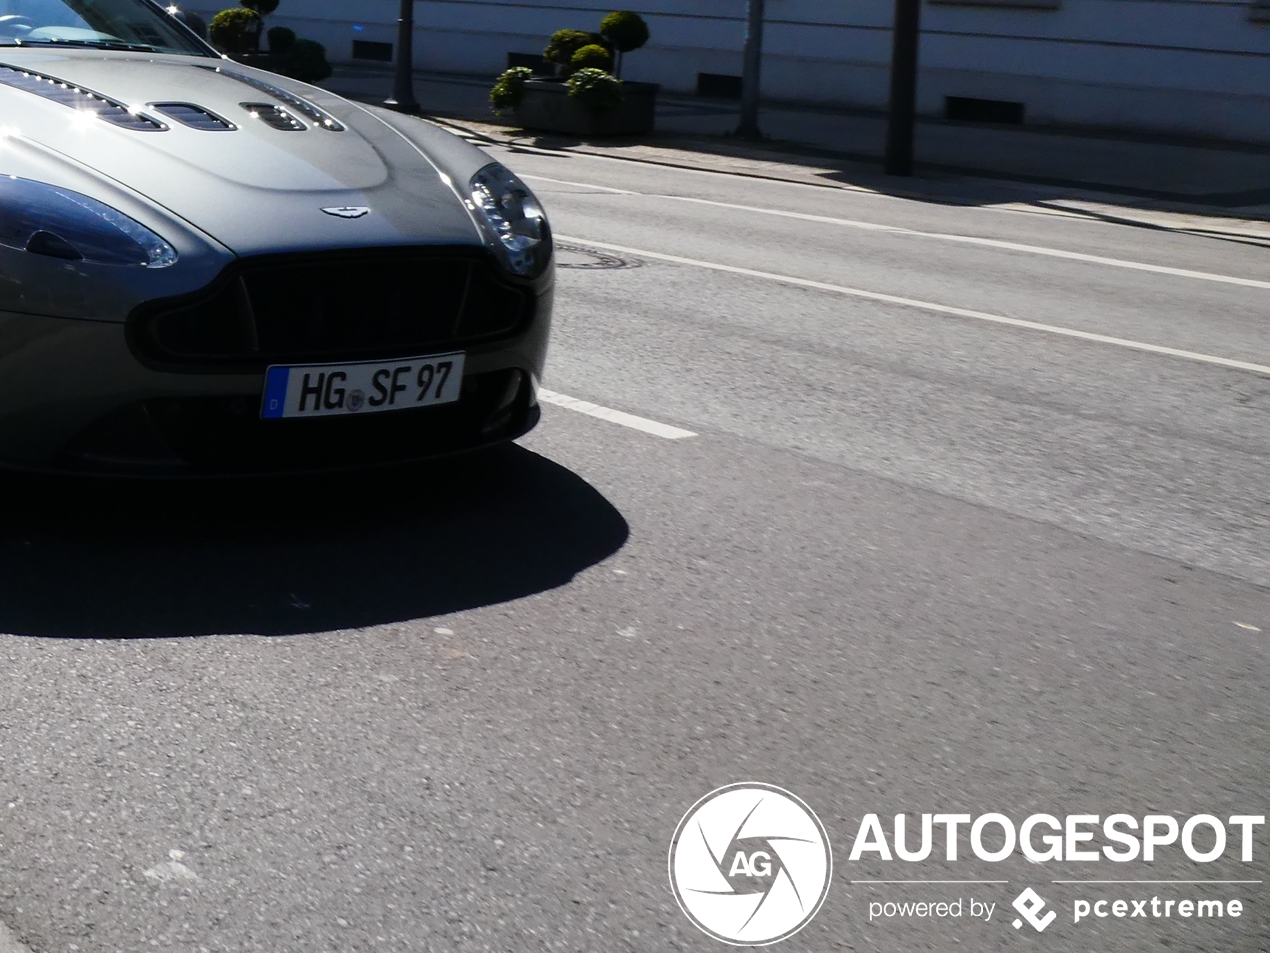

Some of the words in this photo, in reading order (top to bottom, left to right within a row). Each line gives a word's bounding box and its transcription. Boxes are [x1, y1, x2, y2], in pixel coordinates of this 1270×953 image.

[298, 371, 348, 412] HG
[368, 365, 412, 408] SF
[416, 360, 454, 402] 97
[269, 399, 279, 411] D
